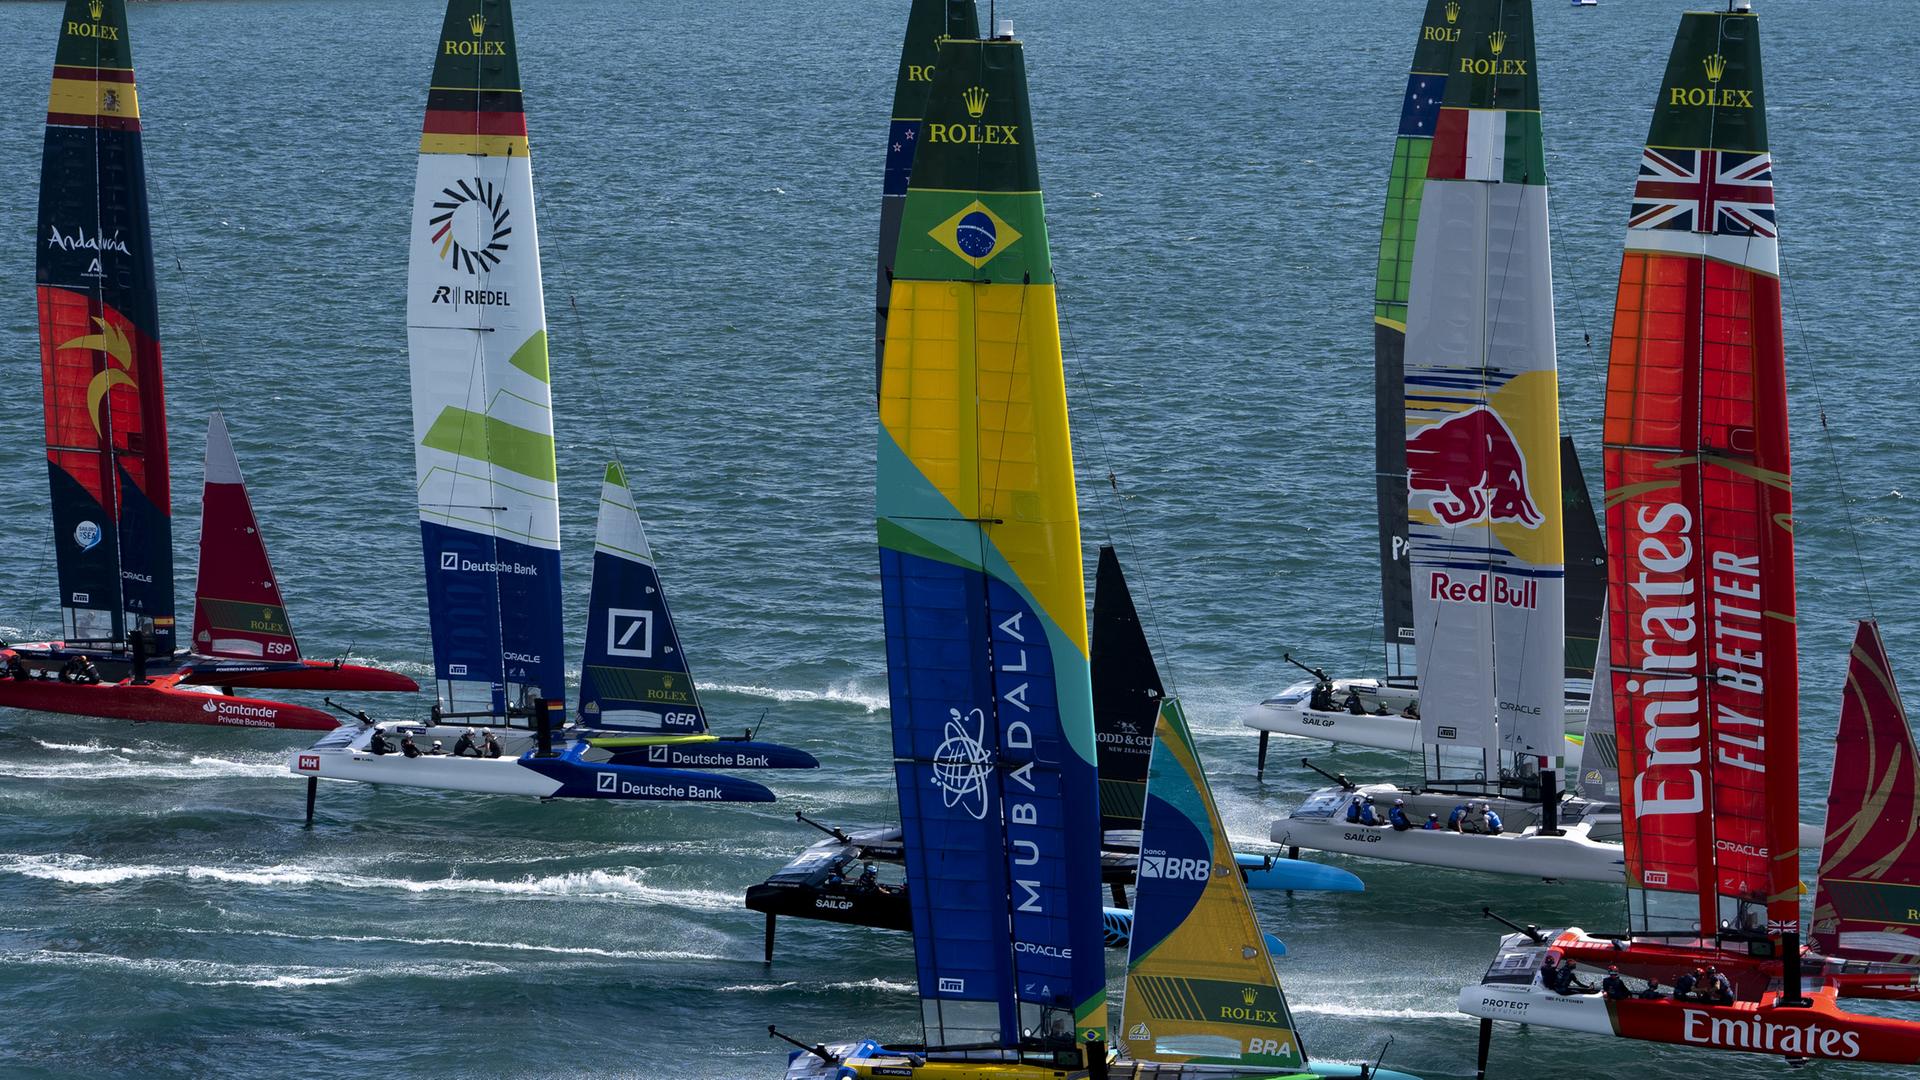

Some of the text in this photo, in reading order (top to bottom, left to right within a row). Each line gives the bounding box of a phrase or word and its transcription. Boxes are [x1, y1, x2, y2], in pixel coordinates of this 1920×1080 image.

[67, 21, 119, 41] ROLEX
[444, 40, 506, 56] ROLEX
[1460, 58, 1527, 76] ROLEX
[1669, 87, 1753, 108] ROLEX
[928, 123, 1020, 145] ROLEX
[464, 289, 511, 307] RIEDEL
[462, 559, 537, 576] Deutsche Bank
[121, 570, 152, 583] ORACLE
[1430, 572, 1538, 610] Red Bull
[251, 620, 284, 632] ROLEX
[267, 642, 292, 655] ESP
[503, 651, 541, 663] ORACLE
[1626, 502, 1704, 819] Emirates
[1712, 550, 1766, 773] FLY BETTER
[647, 688, 687, 701] ROLEX
[219, 702, 278, 718] Santander
[1500, 701, 1541, 715] ORACLE
[218, 715, 275, 728] Private Banking
[665, 712, 696, 726] GER
[1125, 734, 1134, 744] &
[672, 751, 769, 767] Deutsche Bank
[998, 611, 1043, 913] MUBADALA
[621, 781, 722, 799] Deutsche Bank
[1144, 848, 1167, 856] banco
[1716, 839, 1769, 857] ORACLE
[1165, 857, 1210, 881] BRB
[1014, 941, 1072, 959] ORACLE
[1482, 998, 1530, 1010] PROTECT
[1220, 1006, 1280, 1023] ROLEX
[1683, 1008, 1861, 1059] Emirates
[1248, 1037, 1292, 1058] BRA
